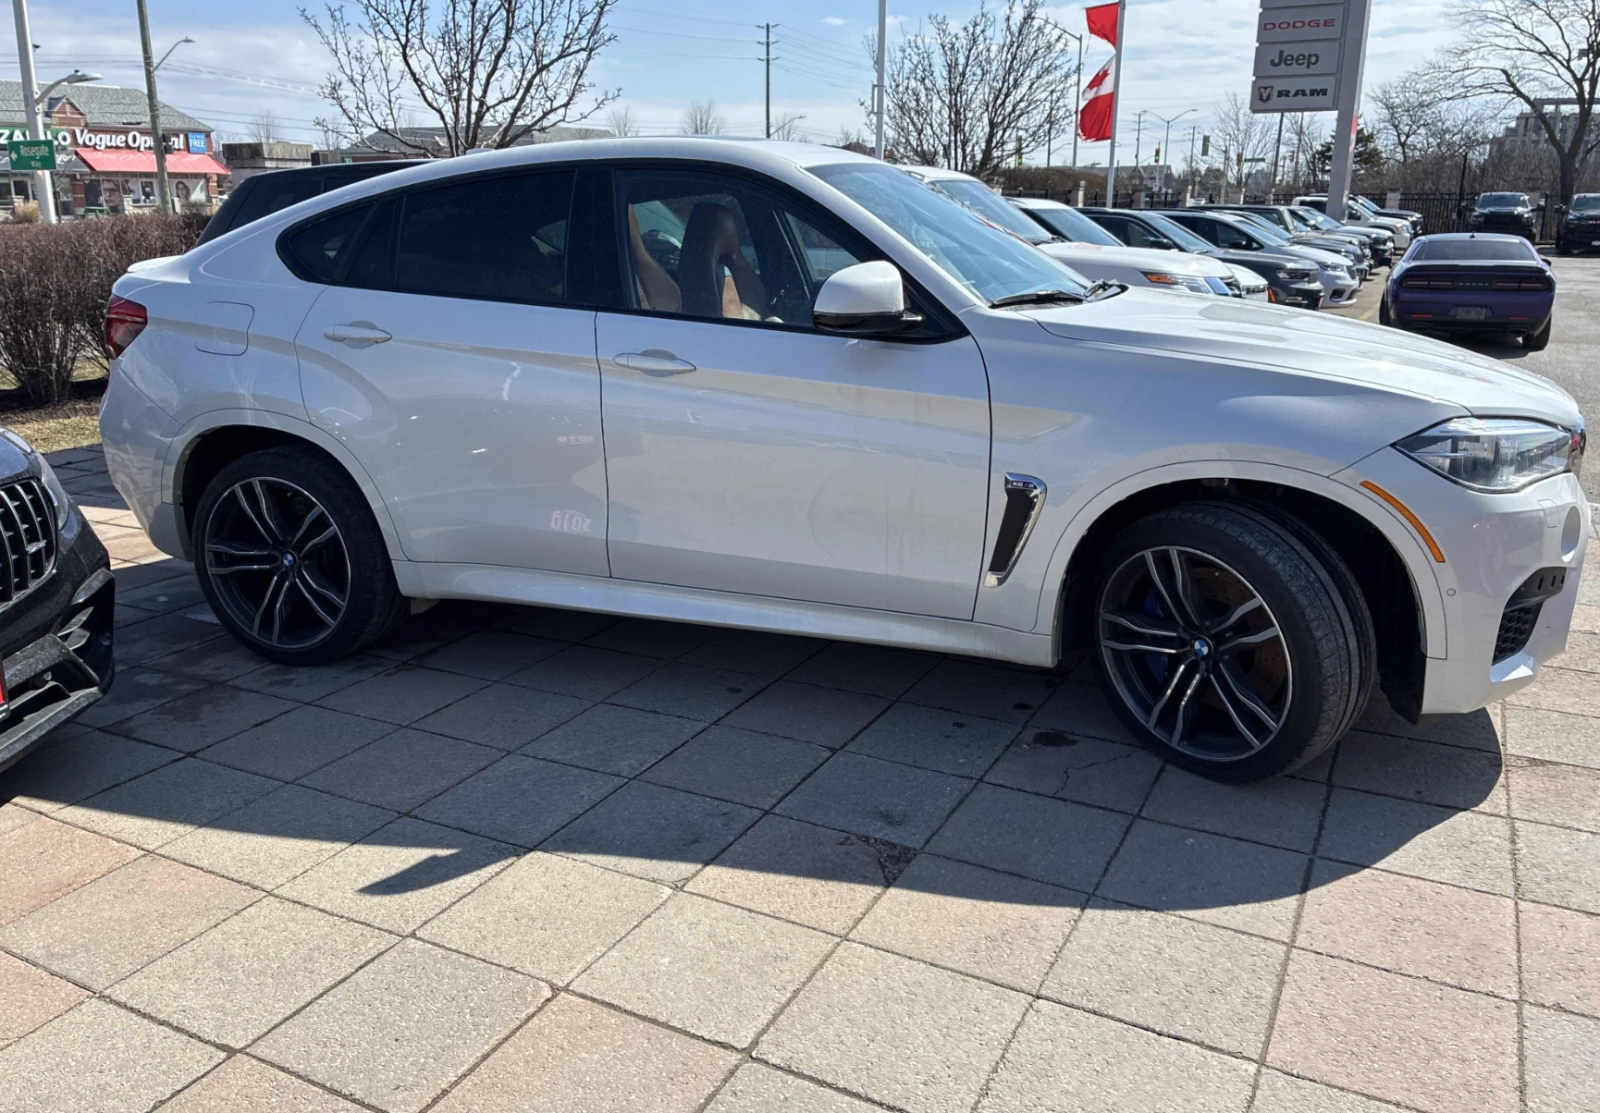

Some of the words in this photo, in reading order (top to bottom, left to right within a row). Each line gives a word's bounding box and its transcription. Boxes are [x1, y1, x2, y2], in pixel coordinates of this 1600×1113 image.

[1263, 18, 1337, 31] DODGE
[1269, 49, 1320, 69] Jeep
[1276, 88, 1328, 98] RAM
[75, 128, 126, 150] Vogue
